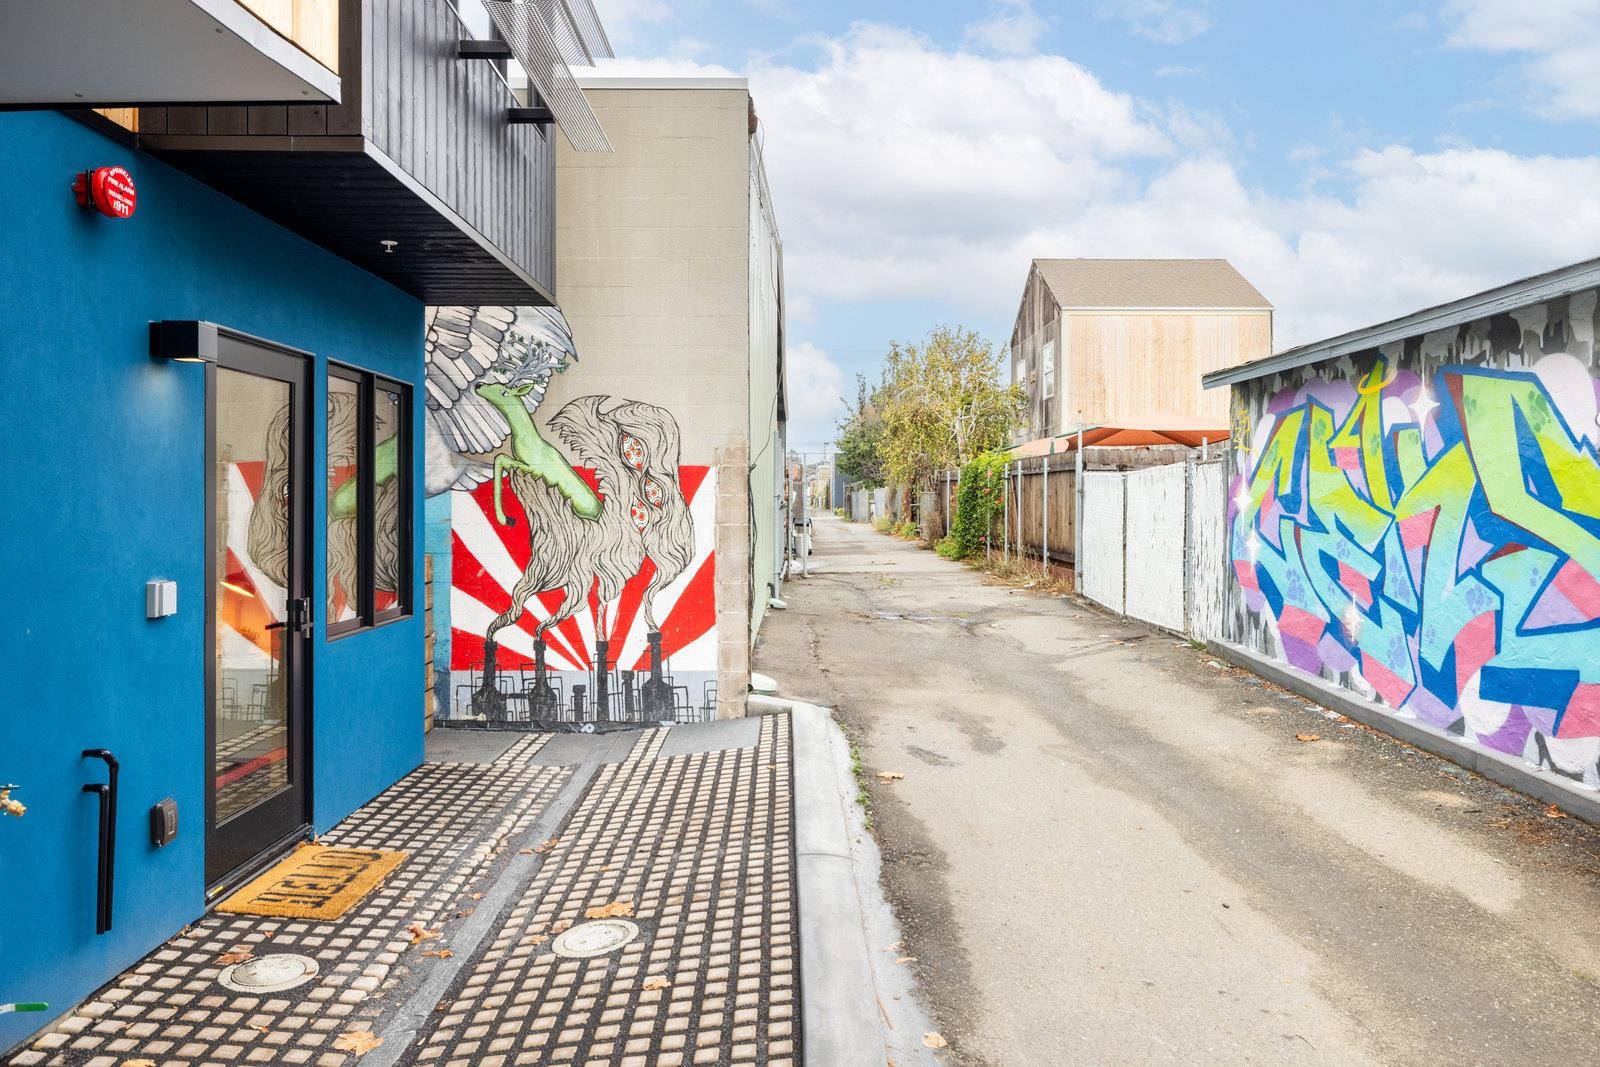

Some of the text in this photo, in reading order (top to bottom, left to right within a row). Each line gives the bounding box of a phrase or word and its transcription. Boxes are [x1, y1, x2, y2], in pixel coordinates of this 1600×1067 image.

[108, 176, 134, 196] FIRE ALARM
[247, 850, 382, 909] HELLO
